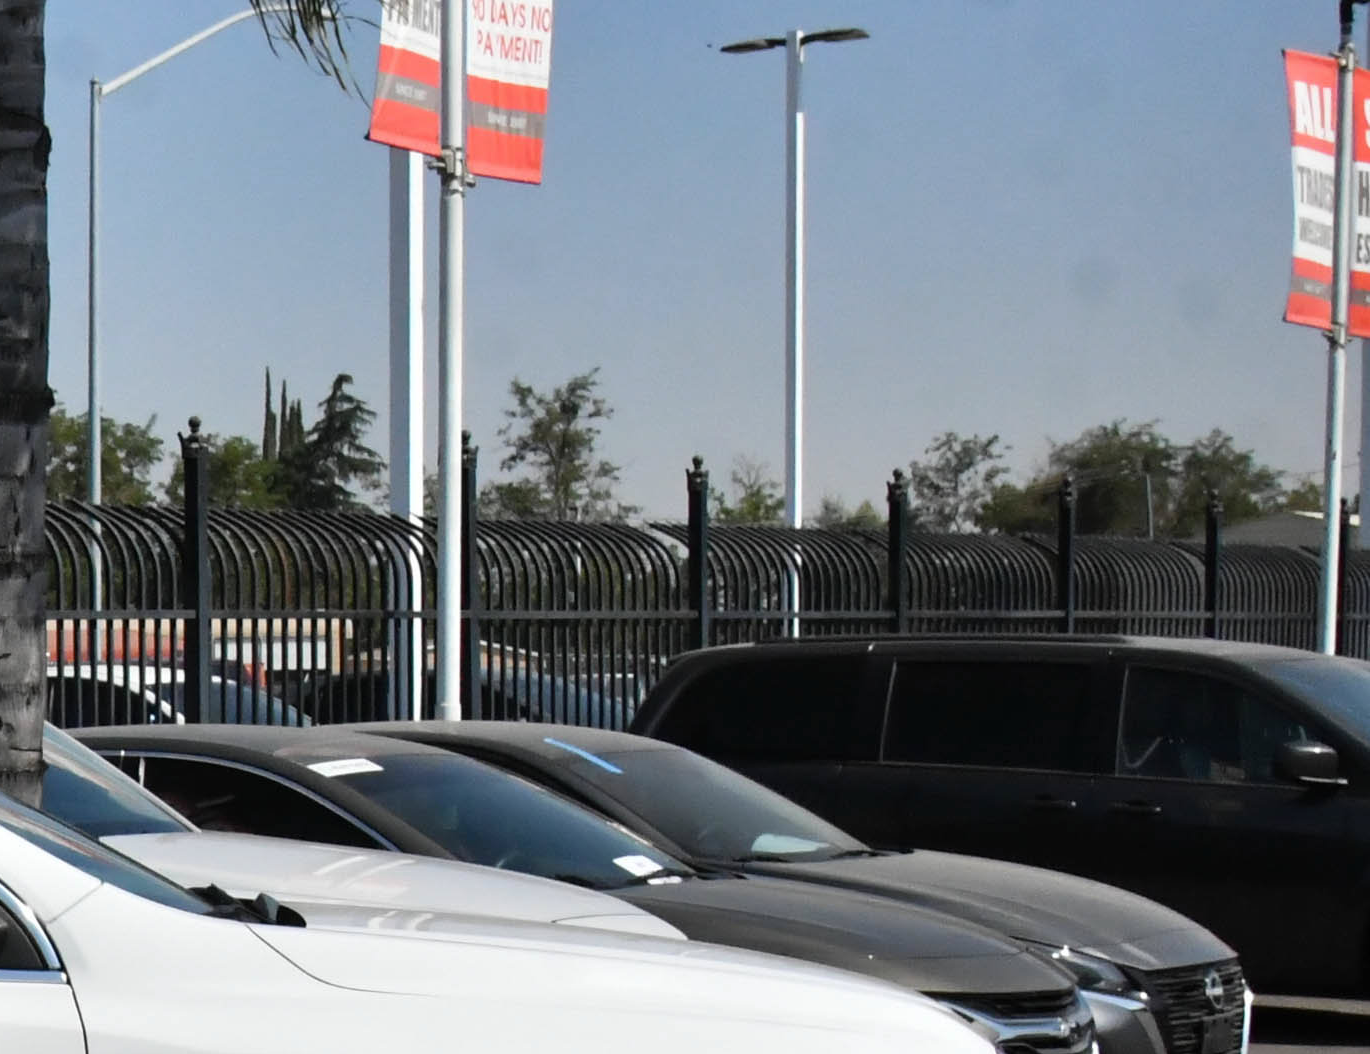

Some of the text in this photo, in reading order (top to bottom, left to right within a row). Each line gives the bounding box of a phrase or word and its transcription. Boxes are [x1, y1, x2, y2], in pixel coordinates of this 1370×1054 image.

[385, 0, 442, 37] PAMENT
[531, 6, 552, 32] NO
[477, 29, 544, 64] PAMENT!
[1294, 80, 1335, 142] ALL
